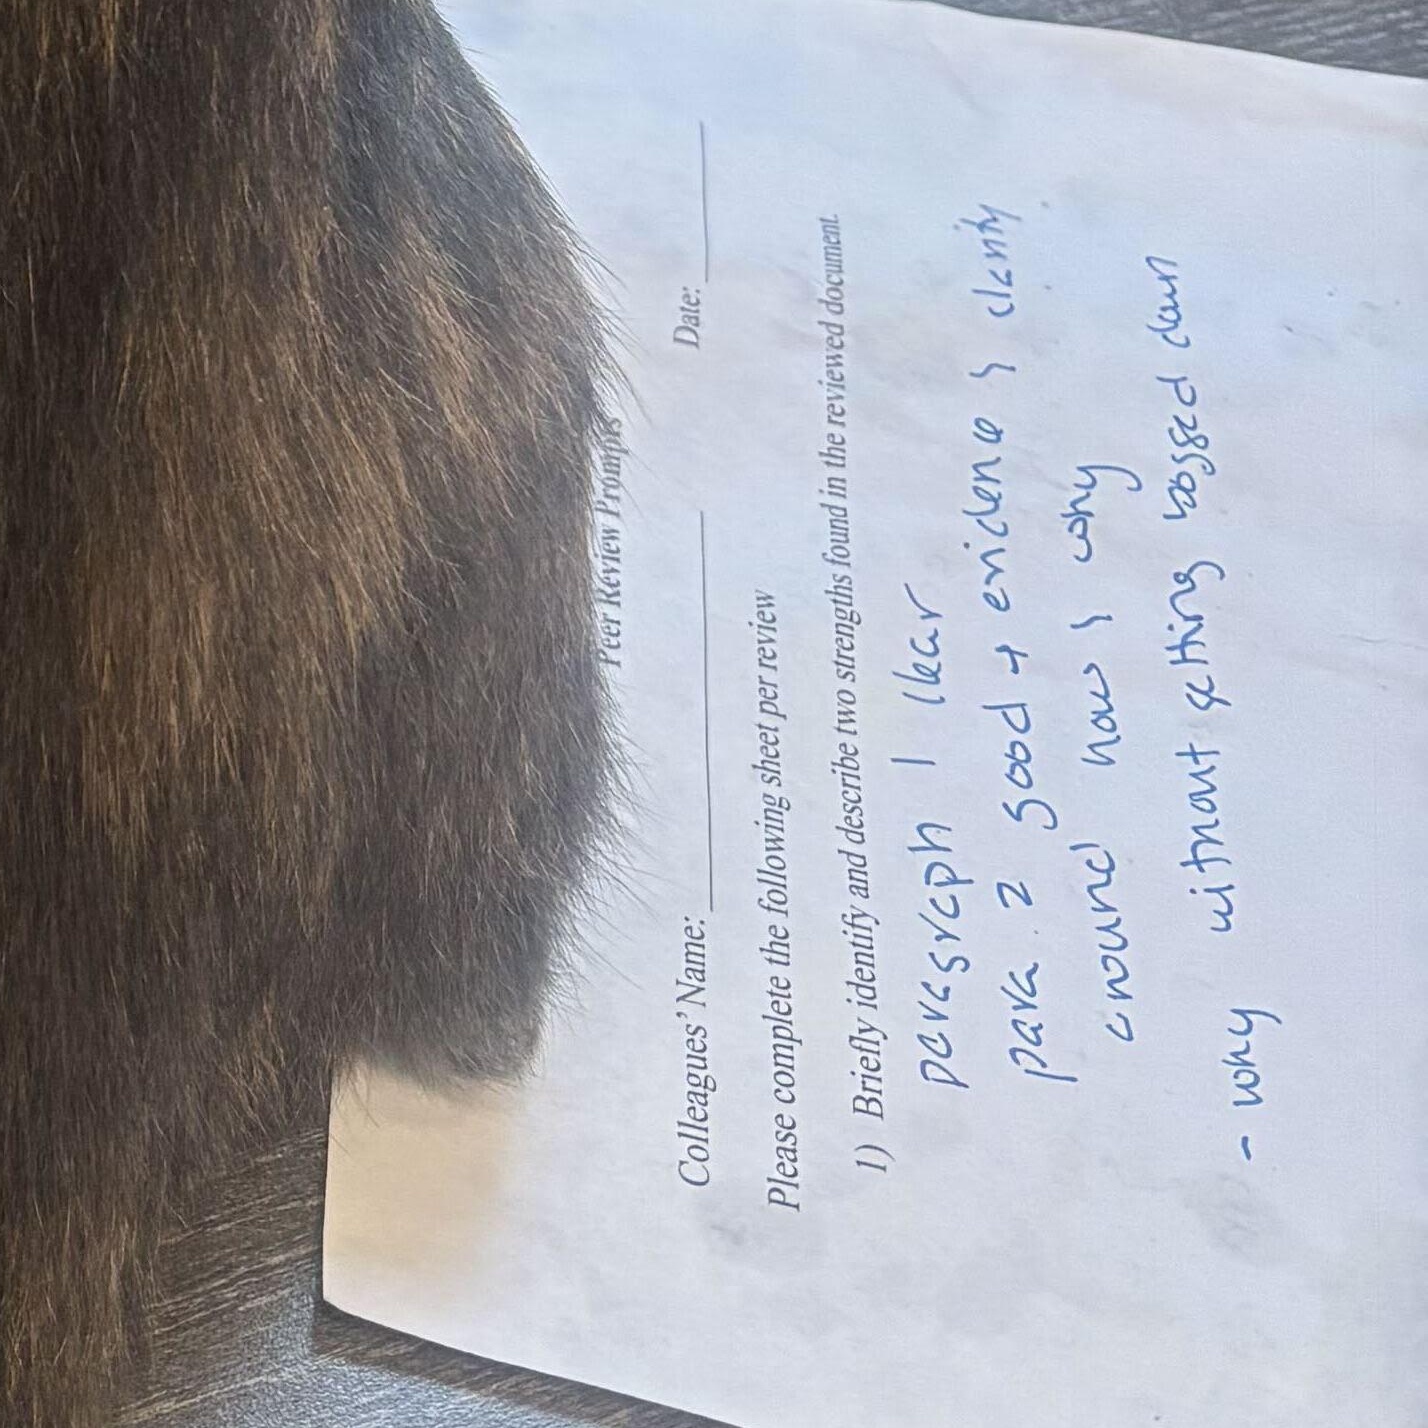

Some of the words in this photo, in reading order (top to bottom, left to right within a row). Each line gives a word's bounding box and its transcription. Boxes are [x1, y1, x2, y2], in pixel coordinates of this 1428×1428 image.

[815, 211, 845, 316] document.
[672, 284, 701, 350] Date:
[816, 318, 846, 427] reviewed
[817, 475, 847, 499] in
[818, 431, 847, 468] the
[819, 500, 852, 567] found
[1059, 462, 1144, 563] why
[593, 524, 622, 608] Review
[595, 611, 622, 668] Peer
[747, 587, 778, 671] review
[823, 571, 861, 683] strengths
[754, 673, 787, 720] per
[831, 687, 857, 736] two
[750, 721, 783, 787] sheet
[829, 740, 865, 845] describe
[753, 791, 791, 919] following
[836, 846, 870, 899] and
[994, 879, 1034, 909] 2
[675, 914, 707, 1007] Name:
[758, 922, 791, 967] the
[840, 903, 880, 1011] identify
[760, 974, 803, 1104] complete
[848, 1016, 888, 1120] Briefly
[1220, 1006, 1284, 1107] why
[765, 1111, 800, 1212] Please
[853, 1142, 896, 1173] 1)
